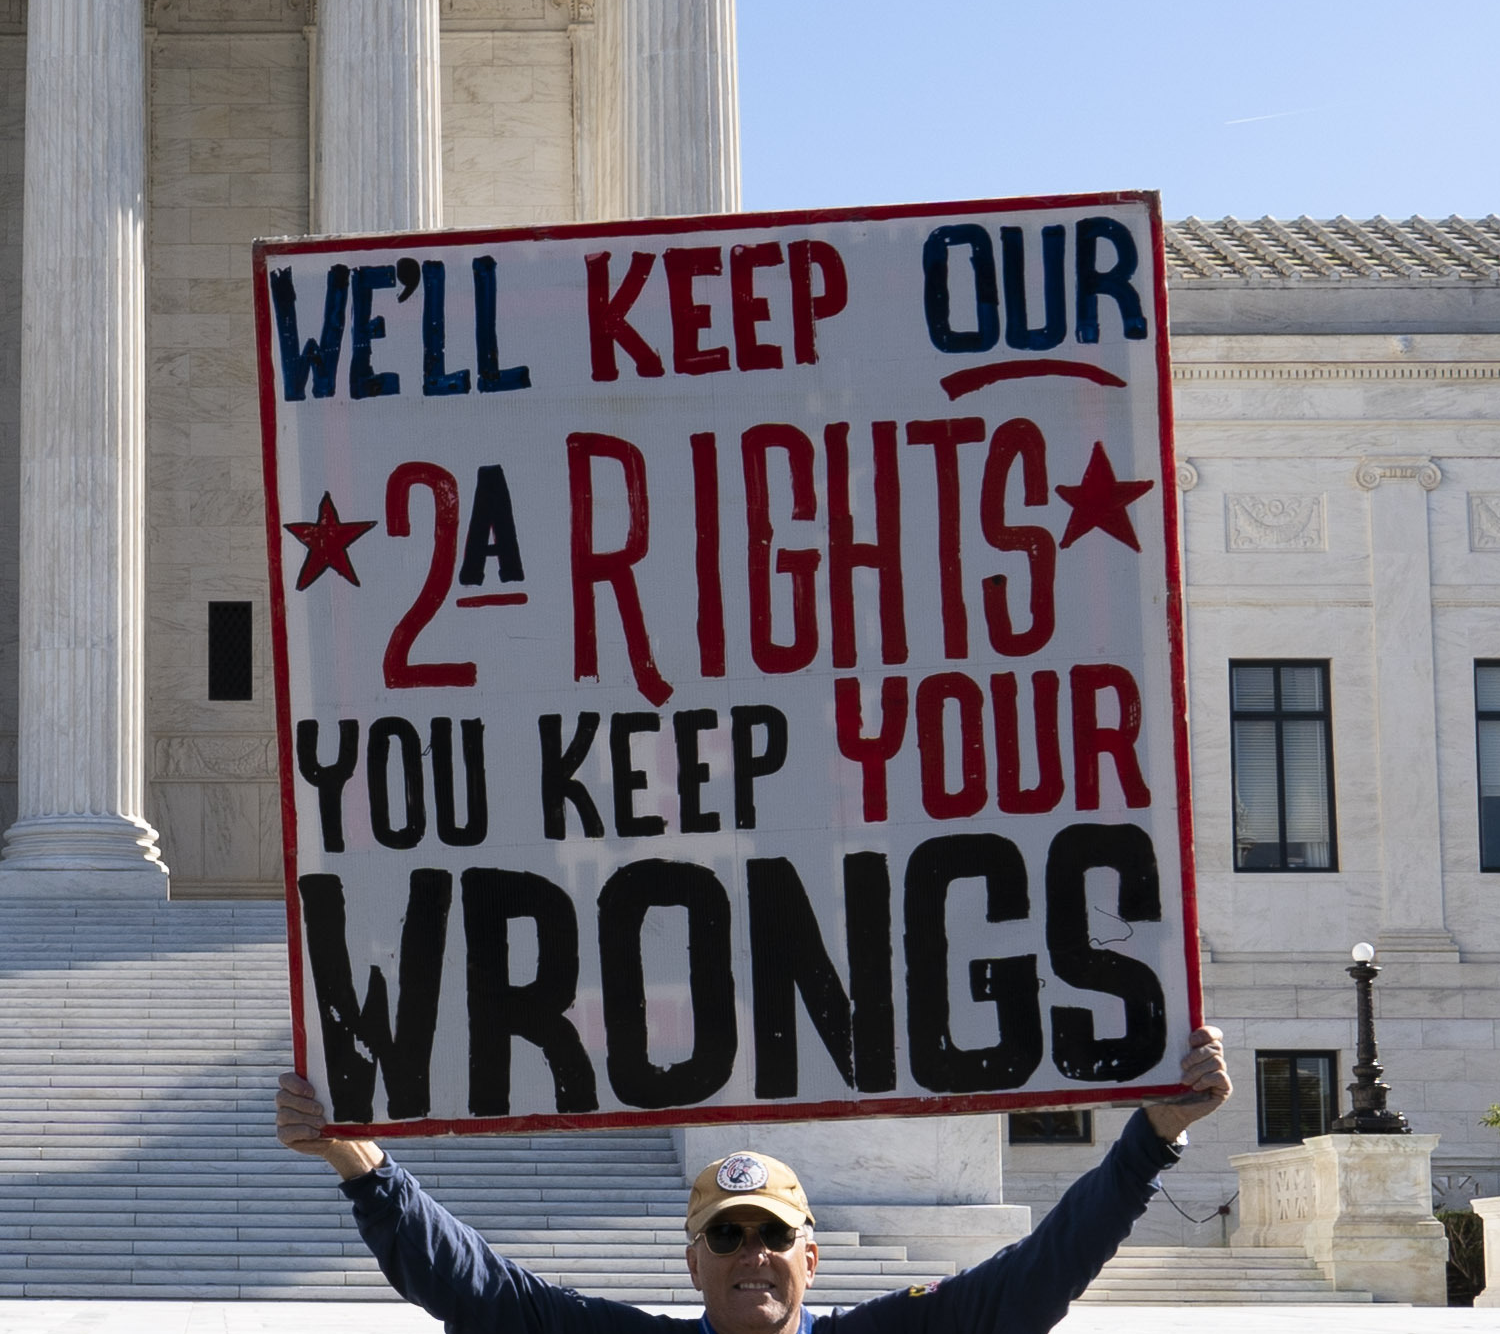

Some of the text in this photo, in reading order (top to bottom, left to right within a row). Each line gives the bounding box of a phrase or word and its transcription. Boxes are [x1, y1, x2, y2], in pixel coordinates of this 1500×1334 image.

[270, 216, 1148, 403] WE'LL KEEP OUR
[383, 416, 1058, 708] 2A RIGHTS
[296, 663, 1152, 854] YOU KEEP YOUR
[297, 822, 1169, 1125] WRONGS
